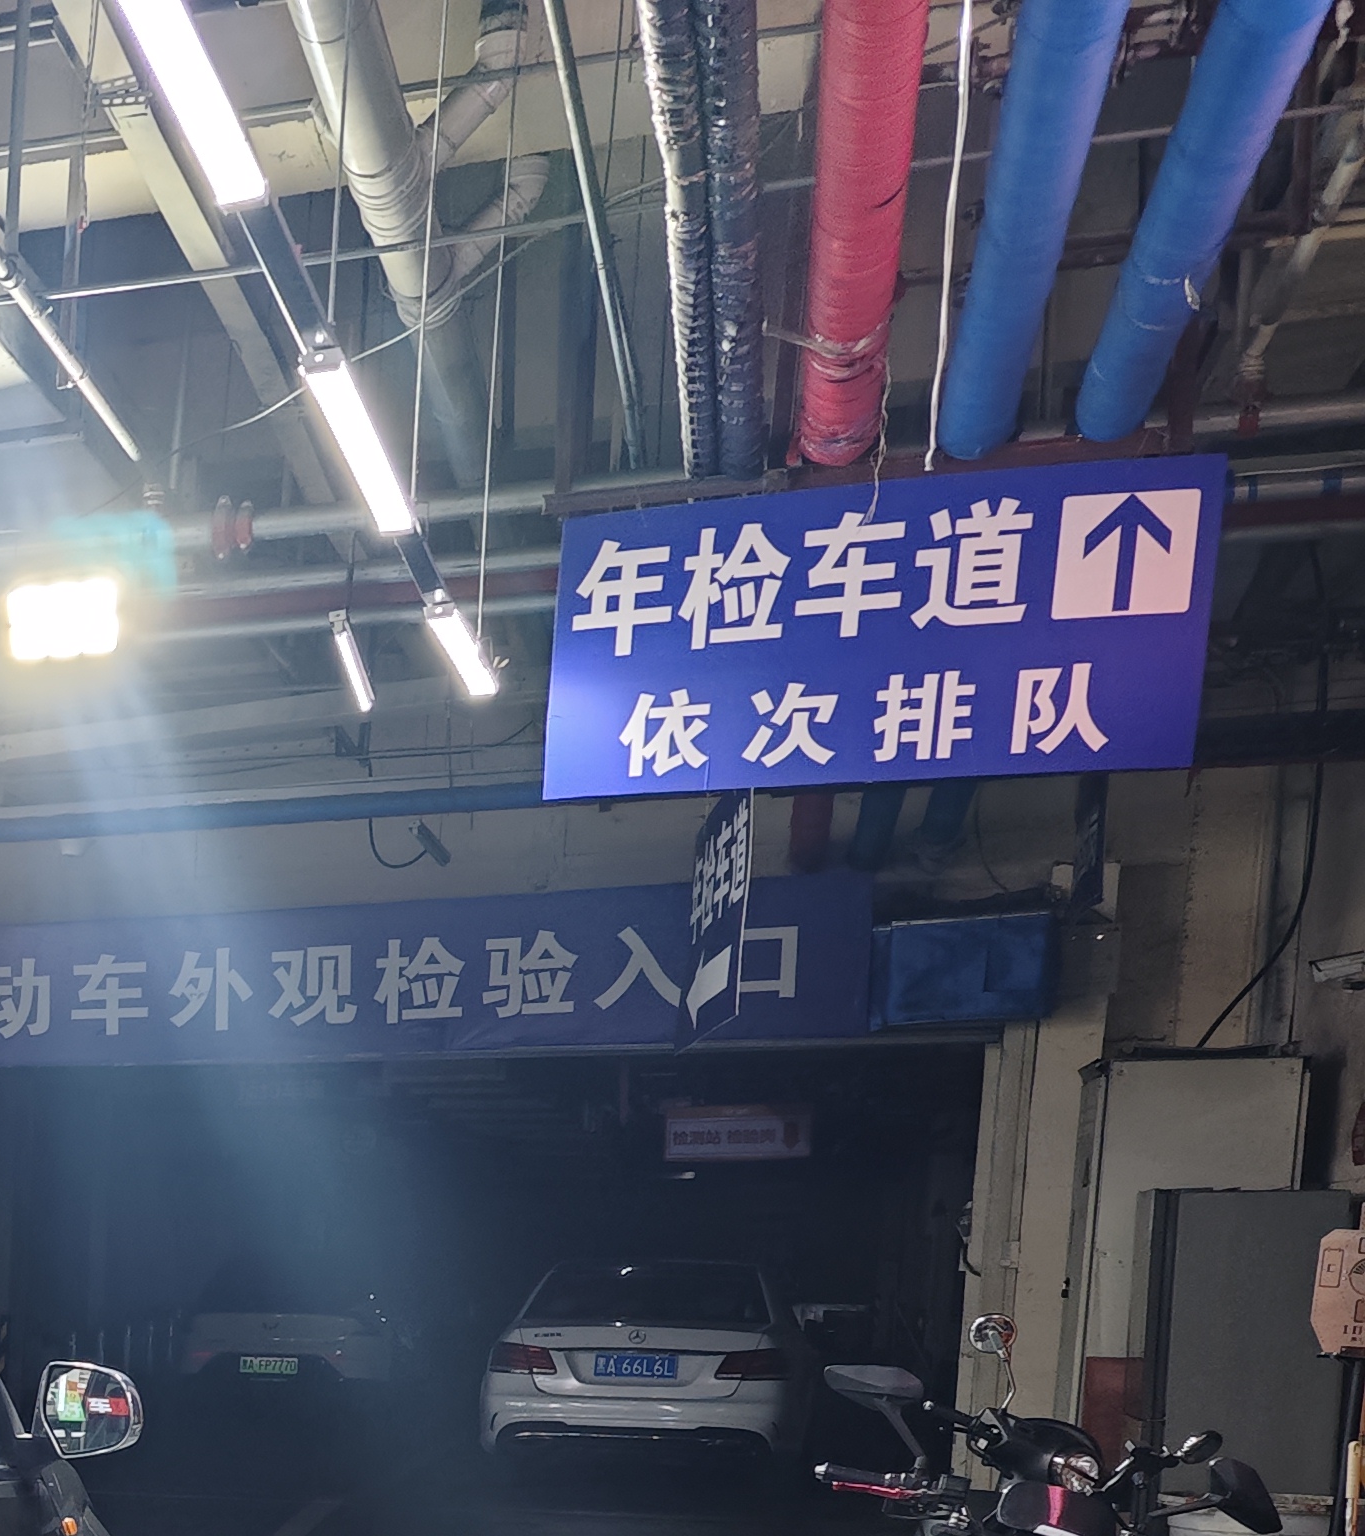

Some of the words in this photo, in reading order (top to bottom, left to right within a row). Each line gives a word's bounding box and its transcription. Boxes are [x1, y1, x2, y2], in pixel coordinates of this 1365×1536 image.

[571, 497, 1034, 657] 年检车道
[619, 662, 1110, 778] 依次排队
[689, 797, 748, 945] 年检车道
